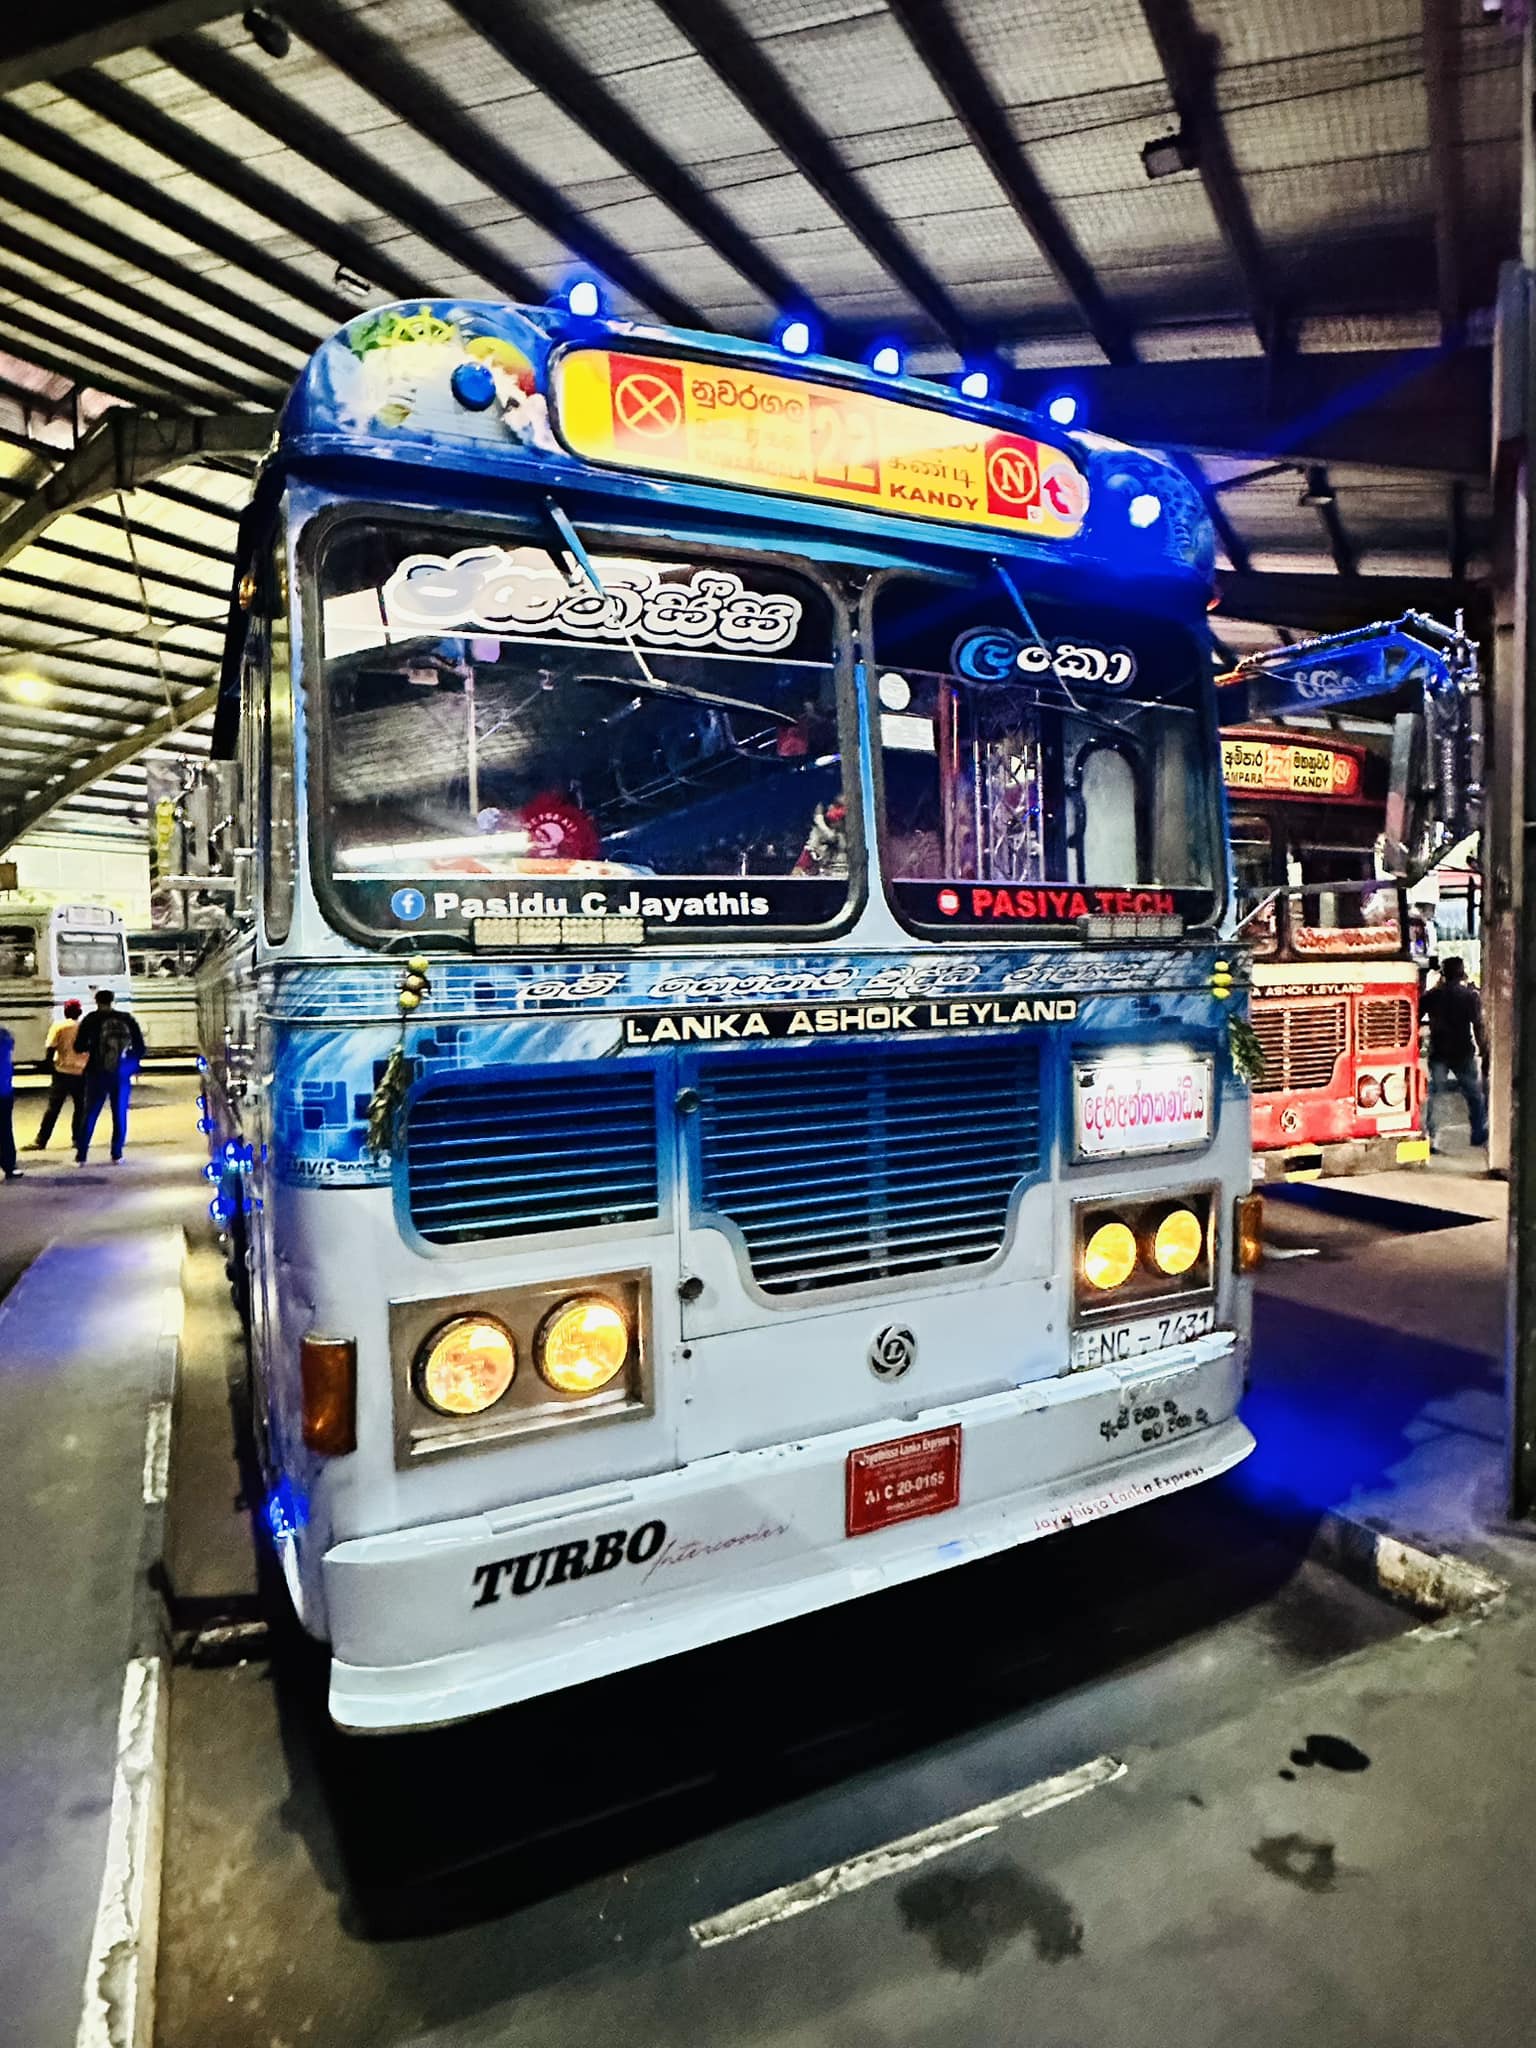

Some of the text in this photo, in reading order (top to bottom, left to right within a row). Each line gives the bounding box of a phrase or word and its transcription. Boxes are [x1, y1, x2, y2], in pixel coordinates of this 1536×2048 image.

[889, 483, 979, 511] KANDY
[1224, 771, 1264, 785] AMPARA
[1293, 775, 1329, 788] KANDY
[434, 892, 568, 919] Pasidu
[580, 892, 608, 916] C
[617, 891, 770, 922] Jayathis
[972, 888, 1175, 919] PASIYA TECH
[1265, 985, 1308, 997] ASHOK
[1312, 983, 1365, 995] LEYLAND
[626, 999, 1078, 1045] LANKA ASHOK LEYLAND
[472, 1519, 667, 1610] TURBO
